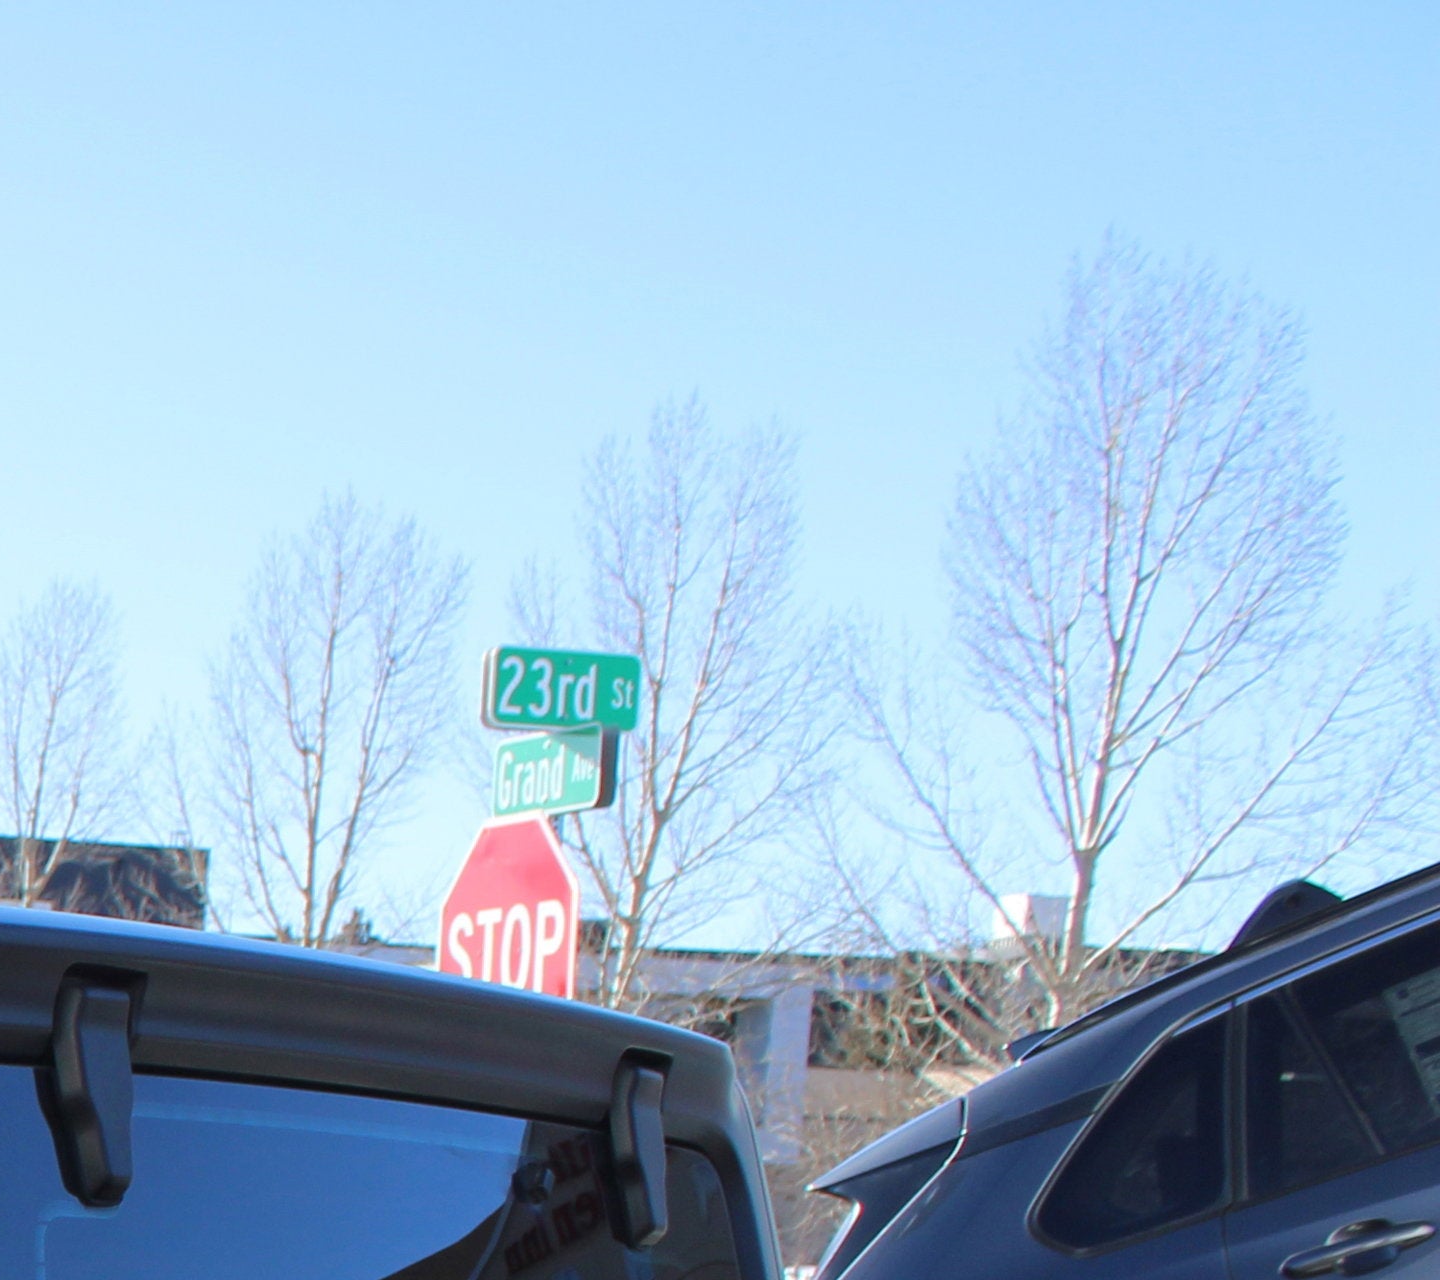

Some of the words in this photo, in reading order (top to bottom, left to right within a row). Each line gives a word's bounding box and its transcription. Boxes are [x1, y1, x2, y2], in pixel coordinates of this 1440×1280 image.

[498, 655, 598, 720] 23rd
[611, 677, 635, 710] St
[498, 744, 565, 809] Grand
[571, 757, 595, 783] Ave
[448, 899, 565, 994] STOP
